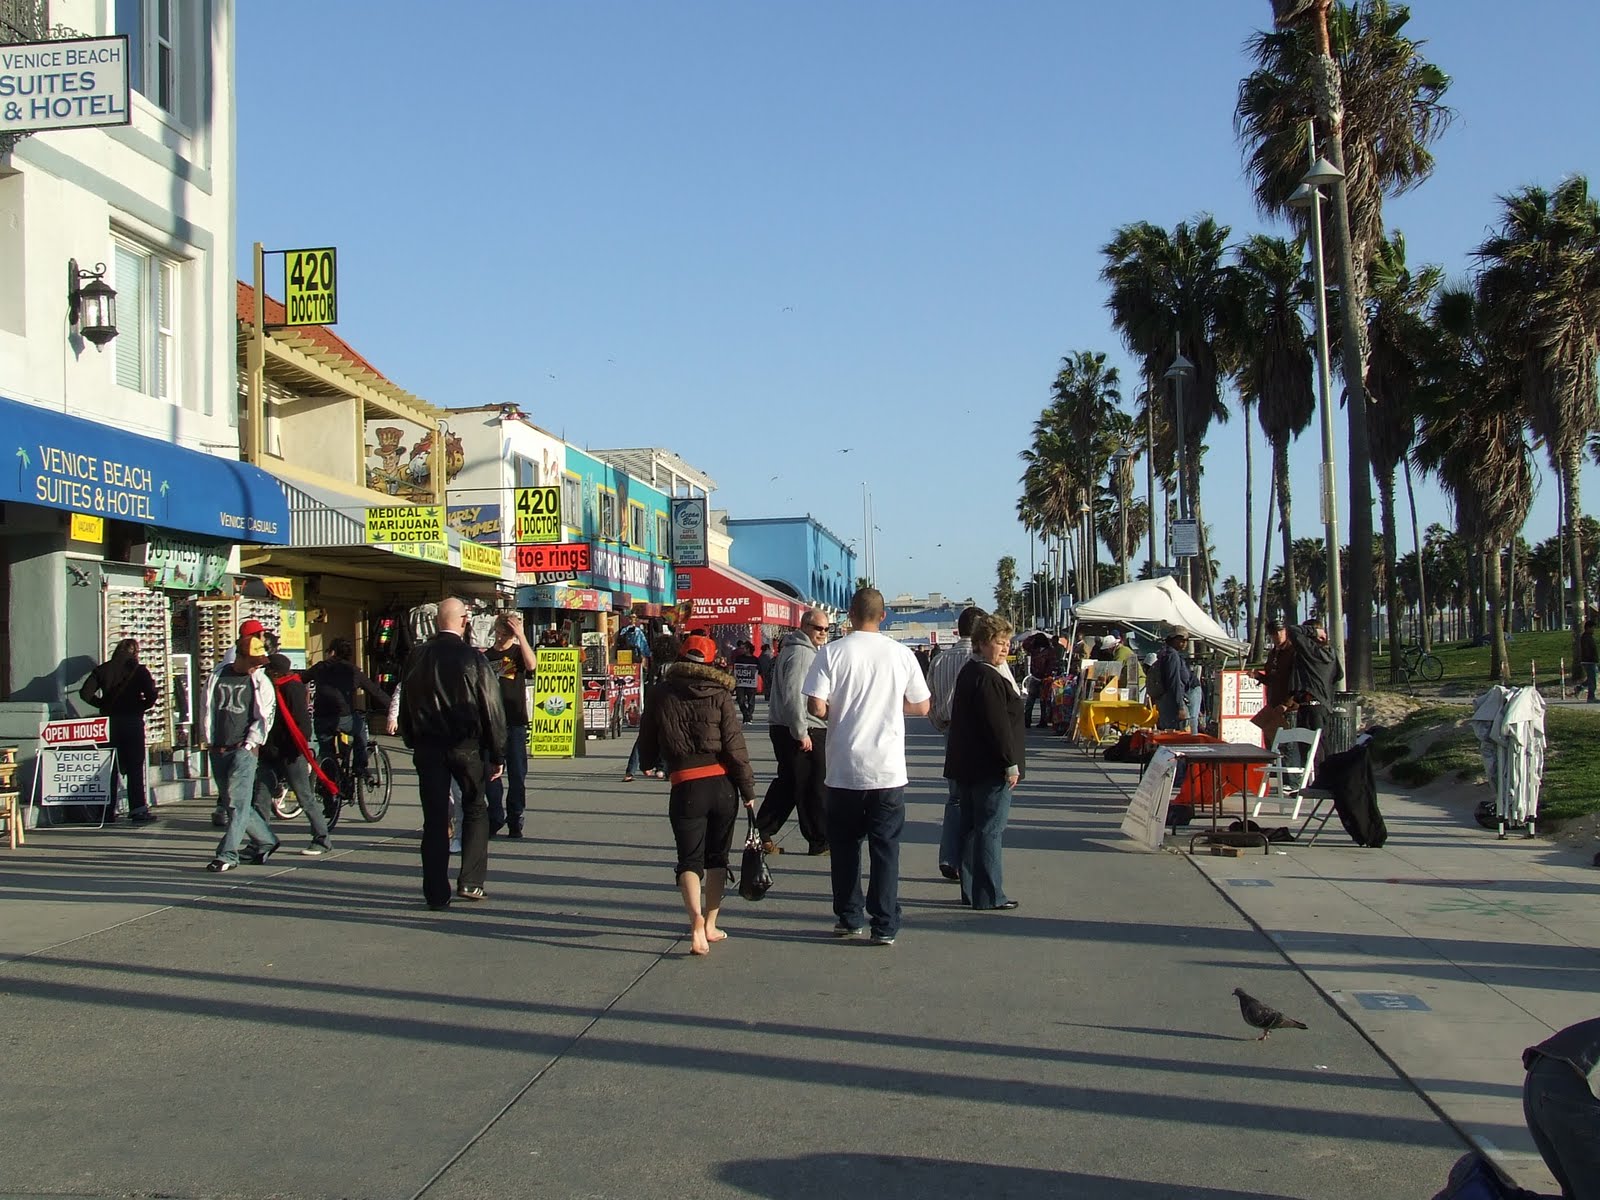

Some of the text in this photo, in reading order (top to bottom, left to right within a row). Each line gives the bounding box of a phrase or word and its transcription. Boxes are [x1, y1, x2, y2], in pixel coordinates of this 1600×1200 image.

[2, 48, 121, 70] VENICE BEACH
[0, 71, 96, 97] SUITES
[5, 95, 125, 120] & HOTEL
[290, 252, 334, 292] 420
[290, 293, 334, 322] DOCTOR
[39, 445, 153, 492] VENICE BEACH
[36, 475, 155, 520] SUITES & HOTEL
[517, 489, 557, 515] 420
[368, 507, 421, 519] MEDICAL
[680, 510, 700, 519] Ocean
[220, 511, 278, 534] VENICE CASUALS
[368, 518, 439, 530] MARIJUANA
[524, 515, 559, 535] DOCTOR
[682, 518, 698, 526] Blue
[390, 530, 440, 542] DOCTOR
[518, 549, 543, 567] toe
[549, 547, 588, 570] rings
[725, 598, 750, 606] CAFE
[716, 606, 736, 614] BAR
[540, 652, 574, 662] MEDICAL
[537, 663, 576, 673] MARIJUANA
[536, 676, 575, 693] DOCTOR
[45, 723, 105, 741] OPEN HOUSE
[535, 719, 560, 734] WALK
[563, 719, 573, 733] IN
[54, 752, 100, 762] VENICE
[57, 762, 100, 772] BEACH
[53, 774, 92, 782] SUITES
[58, 783, 106, 793] HOTEL
